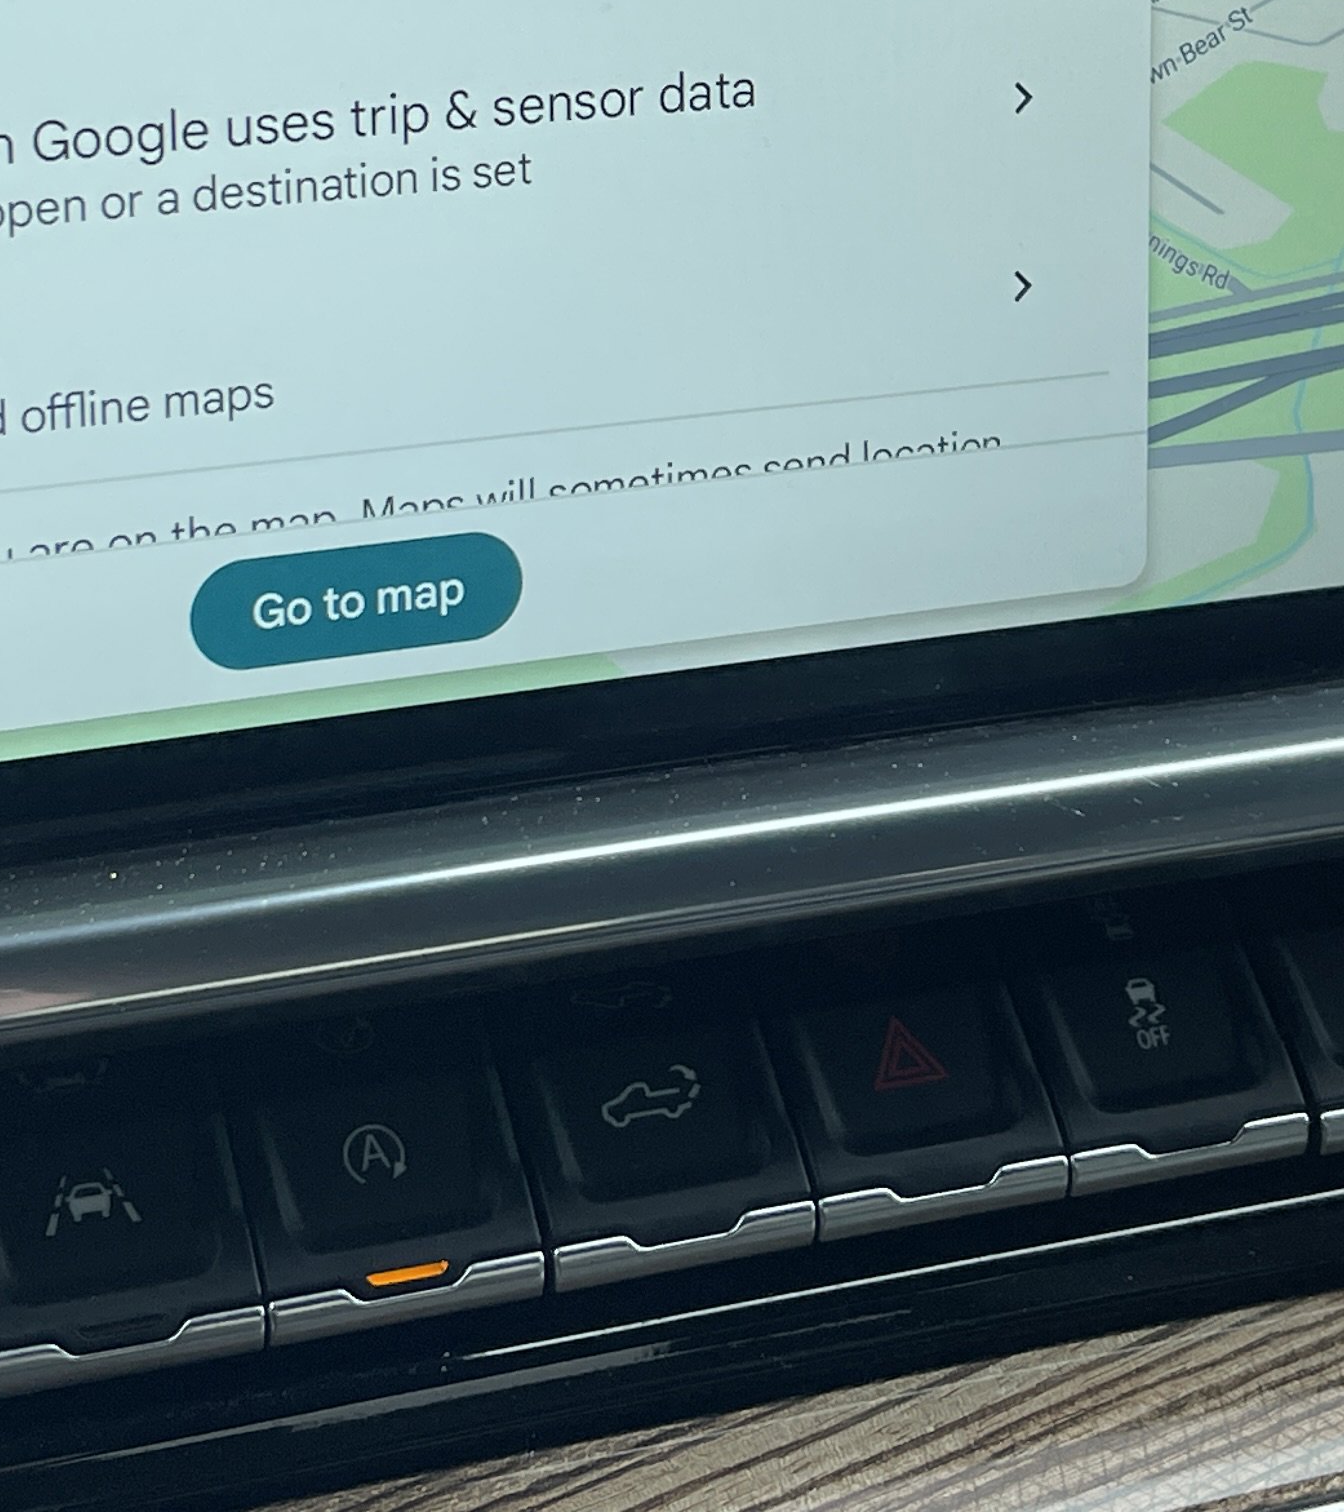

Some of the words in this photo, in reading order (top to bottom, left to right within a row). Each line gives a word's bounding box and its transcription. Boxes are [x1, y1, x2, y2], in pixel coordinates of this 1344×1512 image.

[1179, 25, 1227, 65] Bear
[1227, 5, 1254, 33] St
[32, 108, 209, 167] Google
[226, 106, 336, 148] uses
[350, 92, 431, 146] trip
[444, 88, 479, 131] &
[492, 83, 645, 129] sensor
[658, 71, 758, 115] data
[100, 190, 144, 220] or
[157, 186, 181, 216] a
[192, 160, 419, 213] destination
[431, 155, 462, 193] is
[472, 152, 533, 189] set
[1201, 263, 1230, 290] Rd
[20, 388, 151, 435] offline
[163, 380, 275, 423] maps
[252, 591, 313, 630] Go
[321, 585, 366, 622] to
[375, 575, 467, 618] map
[1136, 1024, 1171, 1050] OFF
